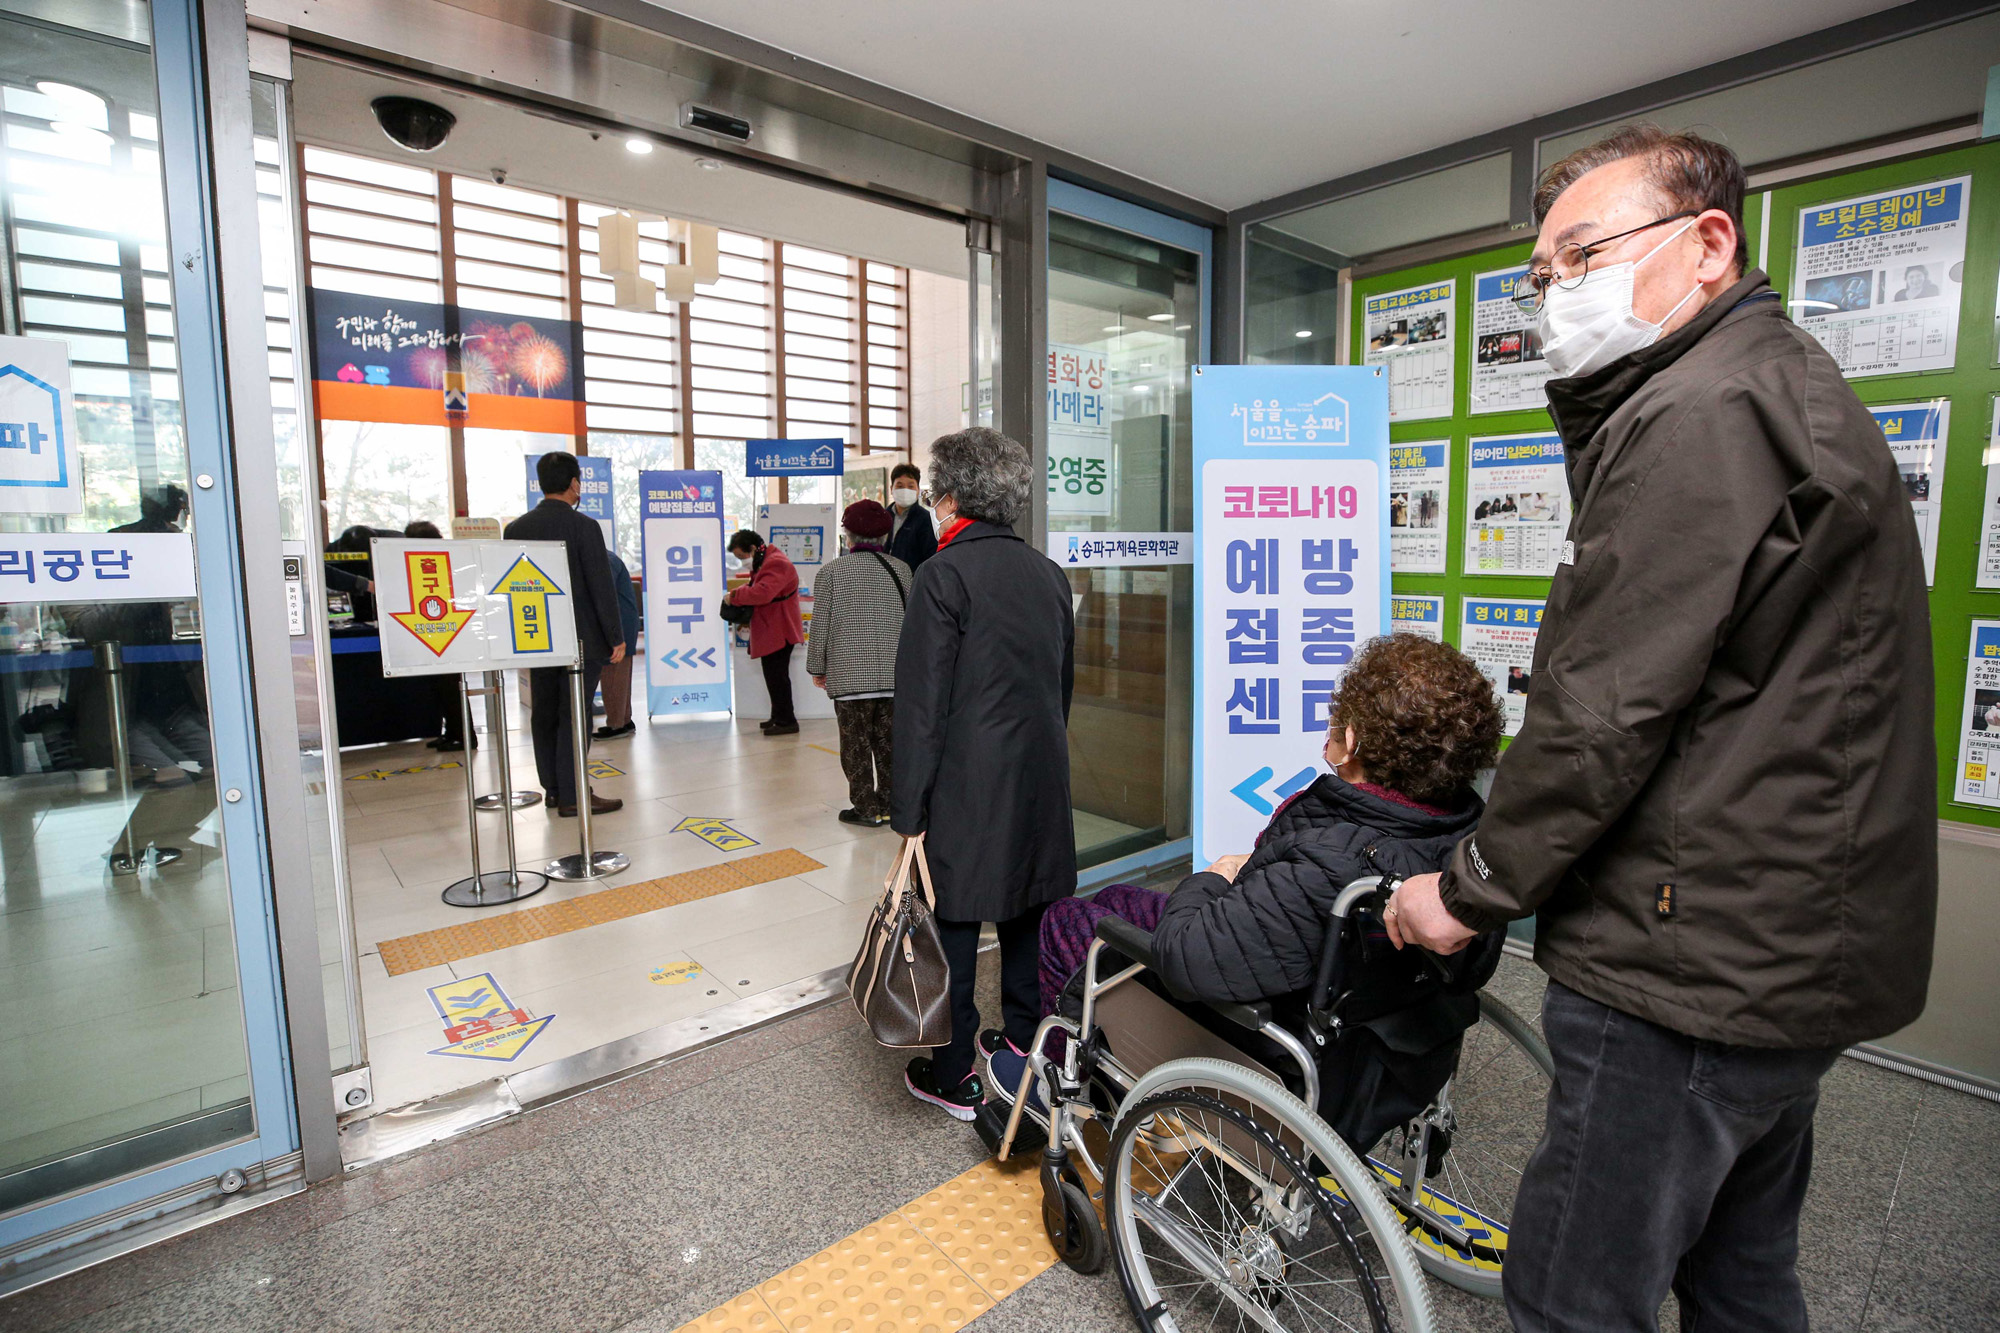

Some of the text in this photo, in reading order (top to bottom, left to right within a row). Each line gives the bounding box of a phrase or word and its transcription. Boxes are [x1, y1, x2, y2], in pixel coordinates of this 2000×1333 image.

[1816, 187, 1946, 227] 보컬트레이닝
[1835, 210, 1922, 239] 소수정예
[336, 309, 417, 340] 구민과 함께
[352, 332, 392, 353] 미래를
[1230, 399, 1283, 422] 서울을
[1250, 414, 1343, 441] 이끄는 송파
[580, 467, 594, 479] 19
[755, 454, 782, 468] 서울을
[782, 454, 808, 467] 이끄는
[809, 451, 831, 466] 송파
[1391, 456, 1427, 468] 수정예반
[648, 490, 684, 500] 코로나19
[648, 501, 716, 514] 예방접종센터
[1224, 485, 1358, 519] 코로나19
[0, 549, 134, 584] 리공단
[420, 558, 440, 594] 출구
[1226, 538, 1359, 595] 예방
[666, 545, 705, 634] 입구
[522, 605, 539, 640] 입구
[1226, 608, 1355, 665] 접종
[681, 692, 710, 704] 송파구
